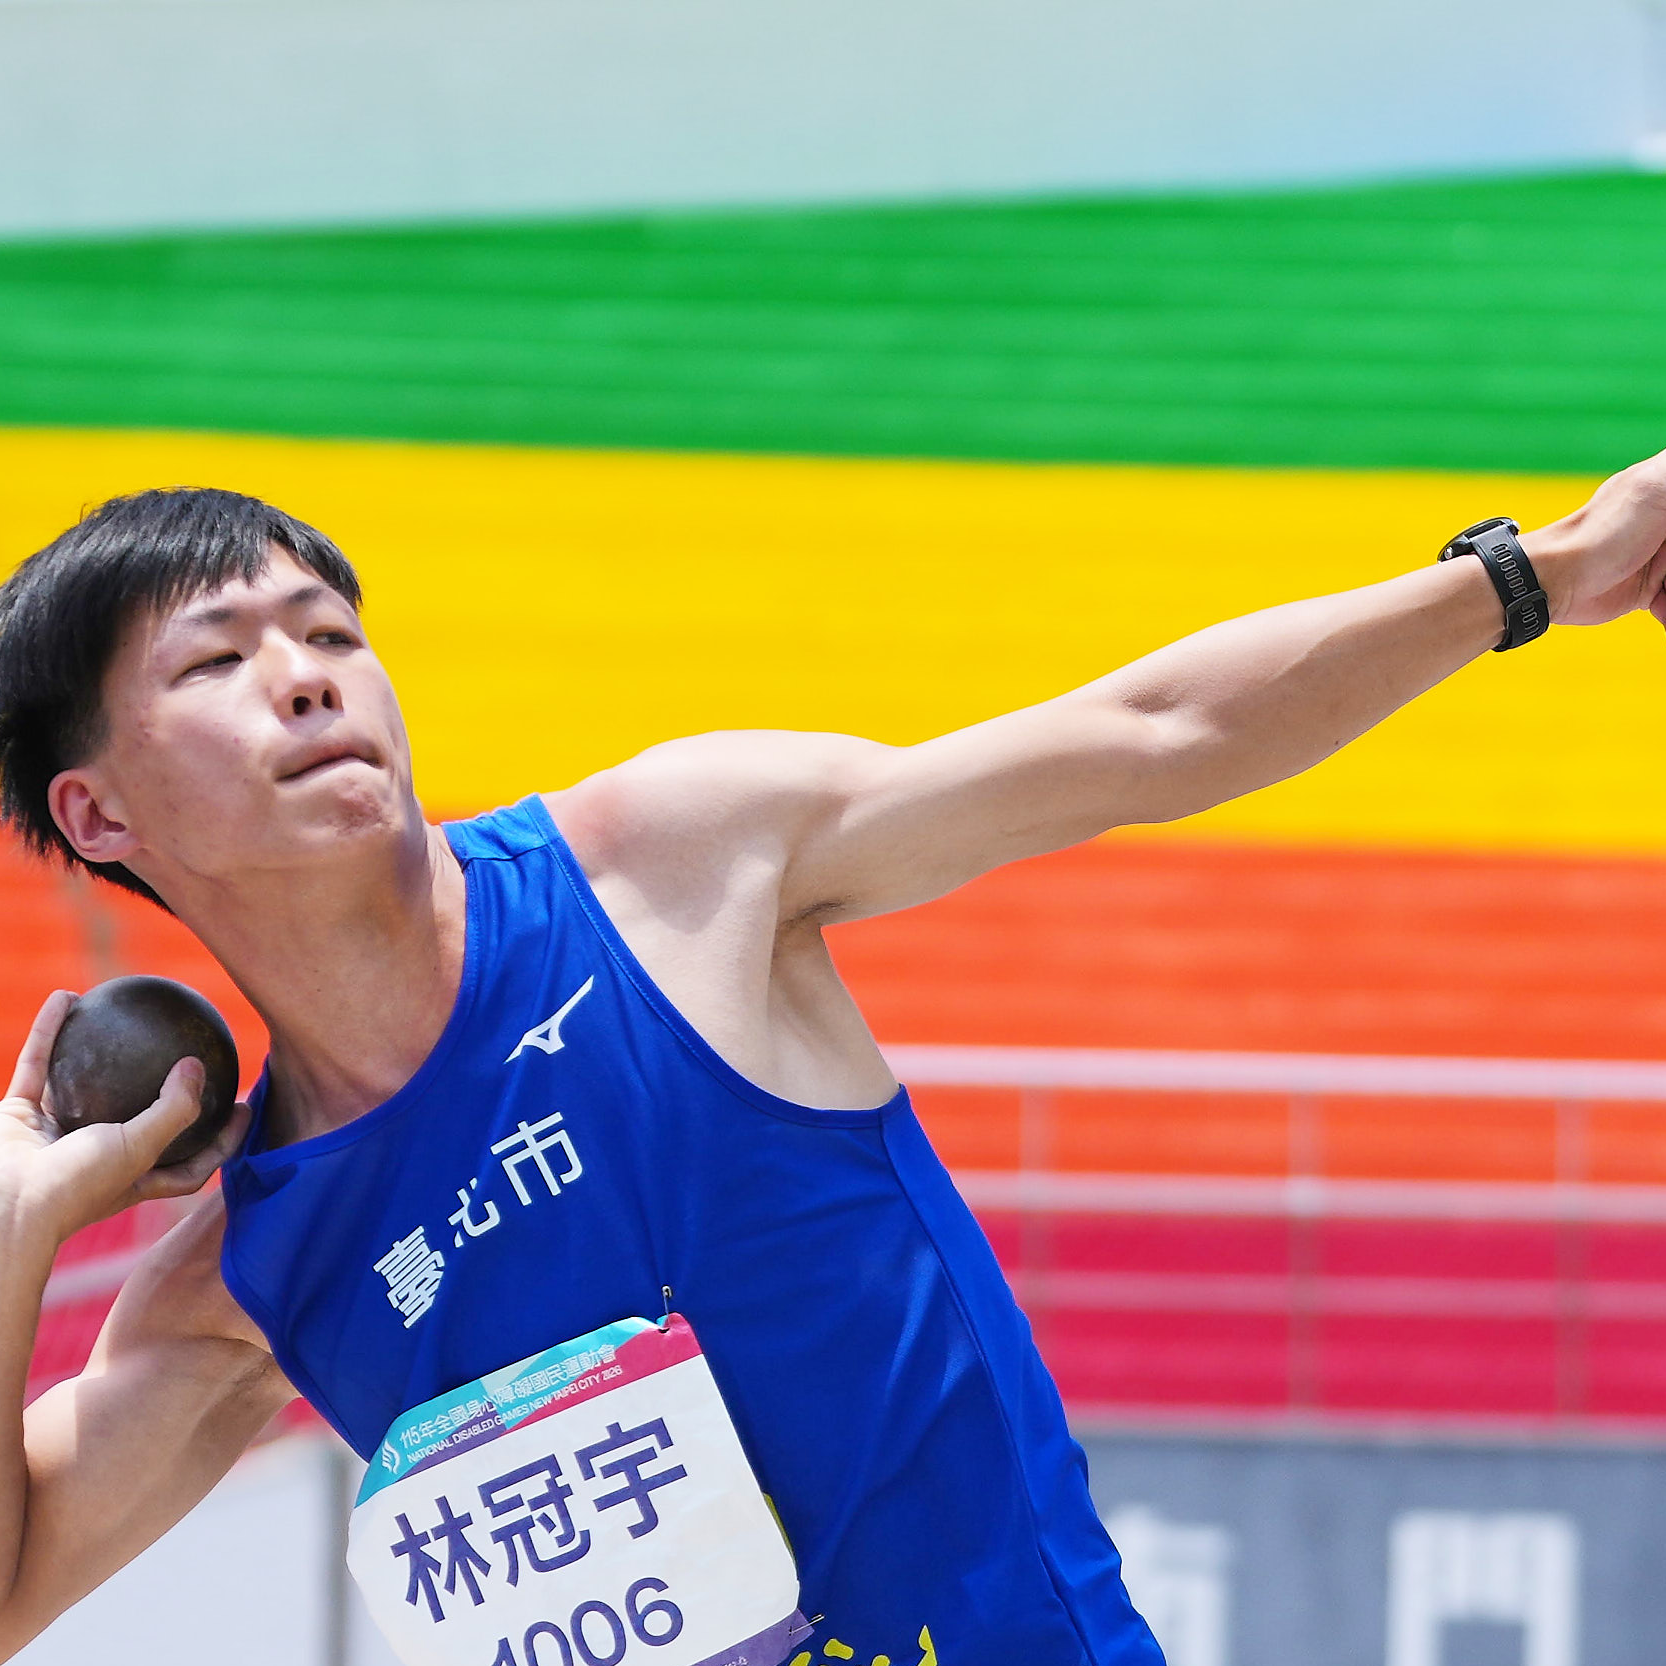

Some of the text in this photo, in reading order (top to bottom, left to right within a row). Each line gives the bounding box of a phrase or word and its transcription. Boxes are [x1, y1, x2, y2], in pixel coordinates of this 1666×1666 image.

[406, 1364, 623, 1463] NATIONAL DISABLED GAMES NEW TAIPEI CITY 2026
[390, 1417, 688, 1624] 林冠宇
